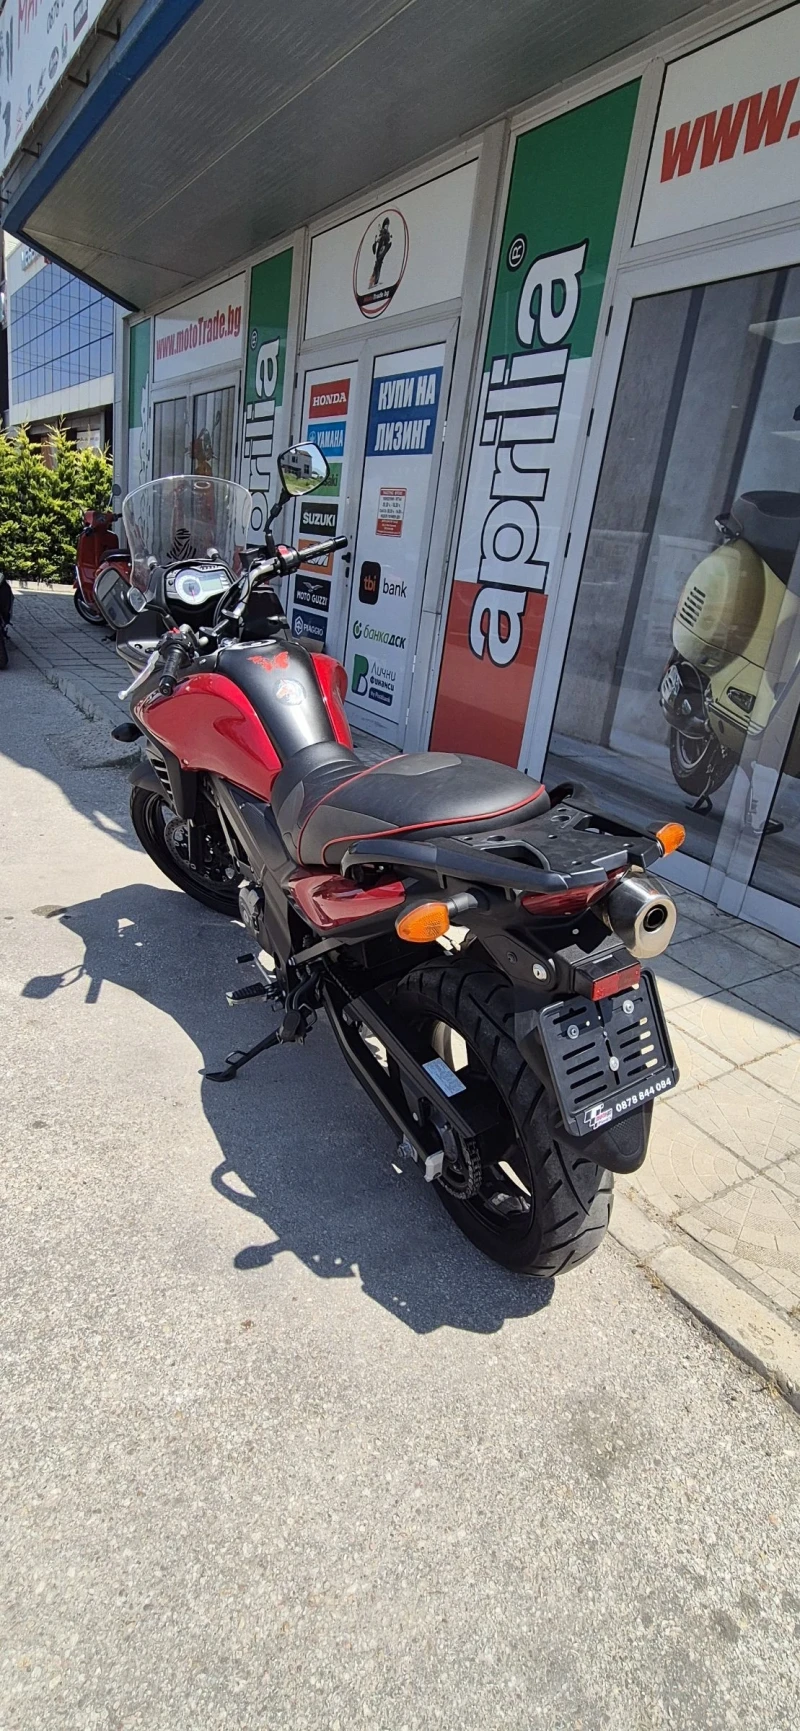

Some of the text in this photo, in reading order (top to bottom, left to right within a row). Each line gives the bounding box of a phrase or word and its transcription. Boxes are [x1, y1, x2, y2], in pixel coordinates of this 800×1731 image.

[156, 304, 242, 361] www.motoTrade.bg
[312, 391, 347, 407] HONDA
[377, 373, 436, 411] КУПИ НА
[317, 429, 344, 448] YAMAHA
[374, 418, 431, 451] ЛИЗИНГ
[468, 238, 589, 669] aprilia
[302, 511, 336, 527] SUZUKI
[296, 590, 328, 606] MOTO GUZZI
[363, 576, 408, 599] tbi bank
[303, 623, 324, 636] PIAGGIO
[371, 661, 397, 682] Лични
[615, 1077, 672, 1113] 0878 844 084
